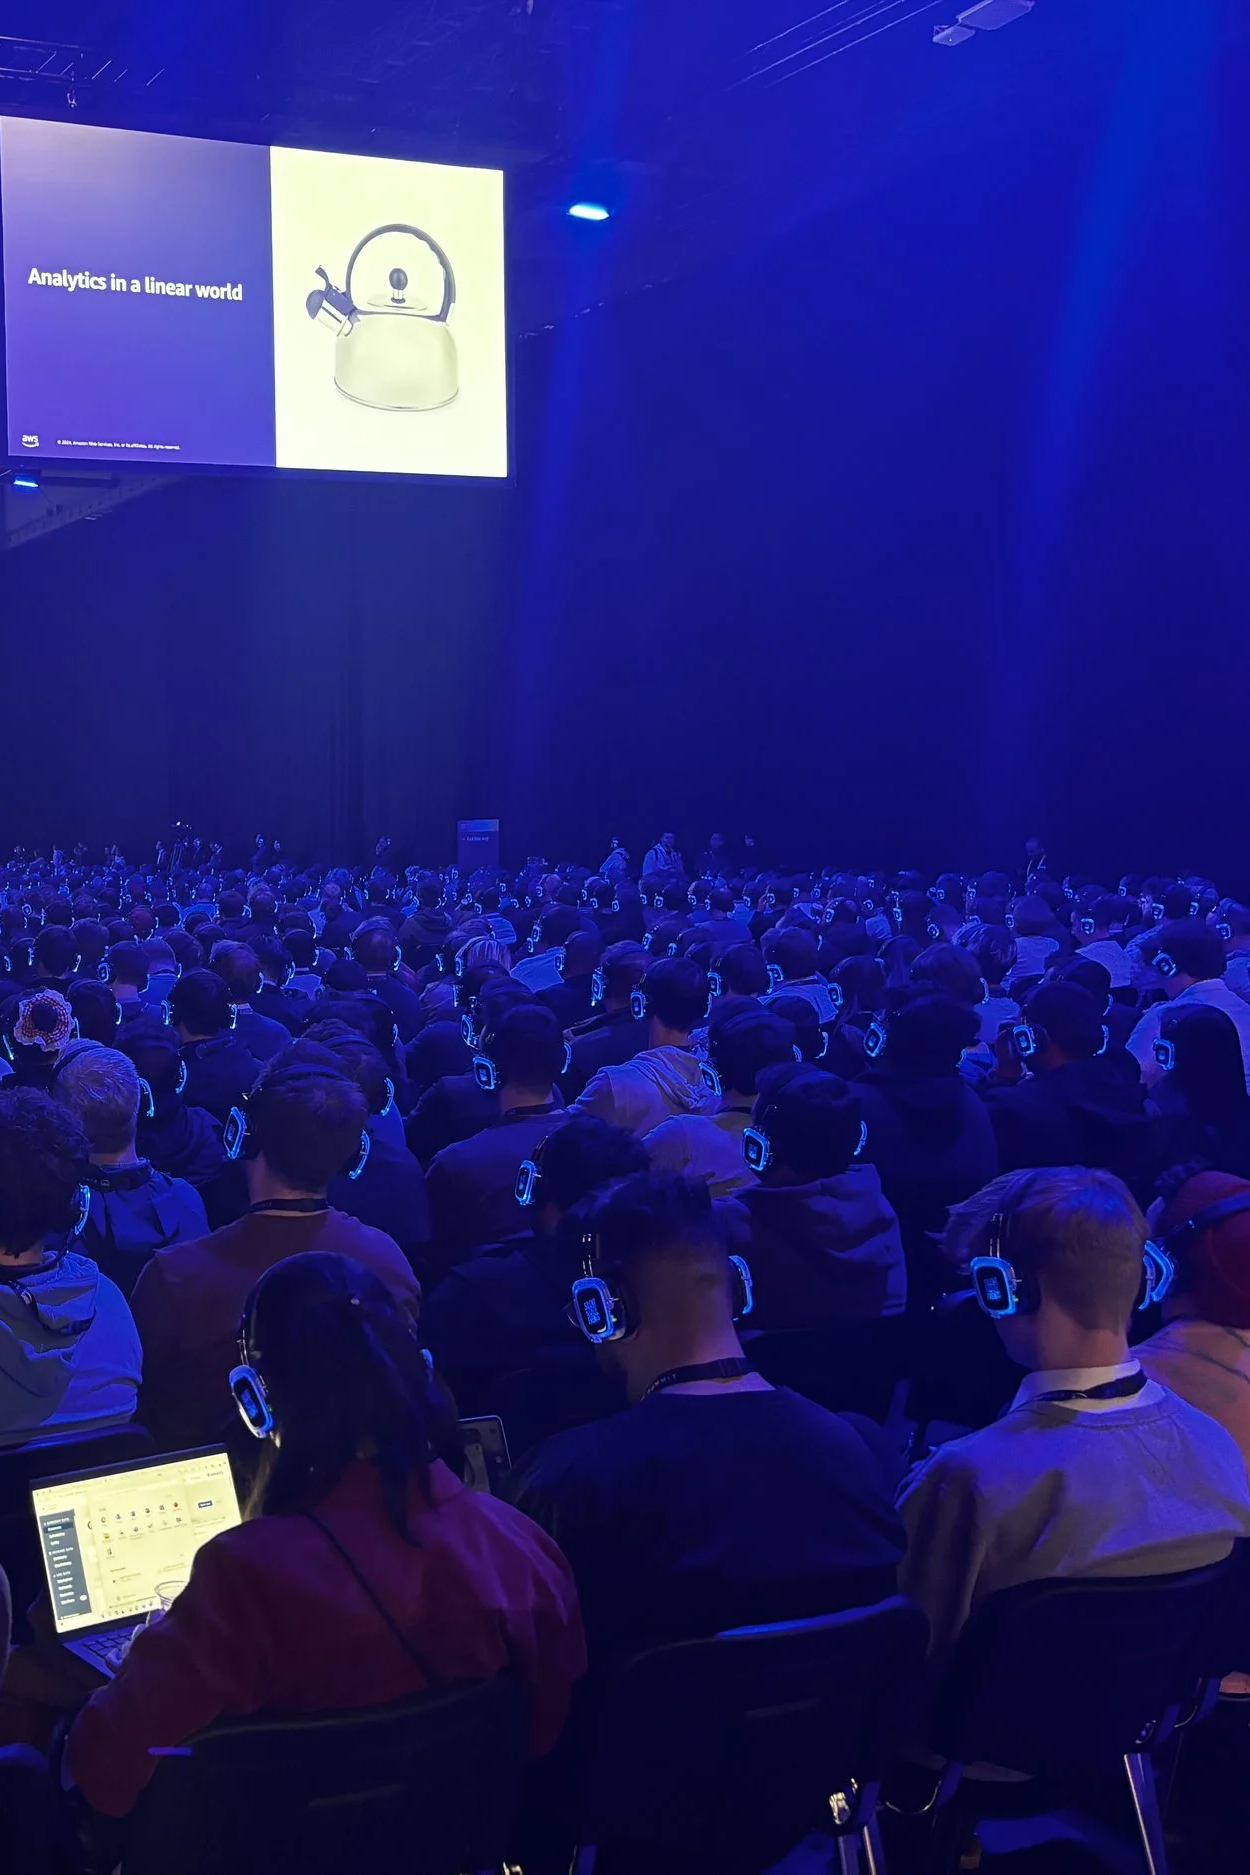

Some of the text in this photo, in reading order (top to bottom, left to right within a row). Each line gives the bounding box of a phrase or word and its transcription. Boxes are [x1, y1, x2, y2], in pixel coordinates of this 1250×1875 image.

[28, 267, 242, 300] Analytics in a linear world
